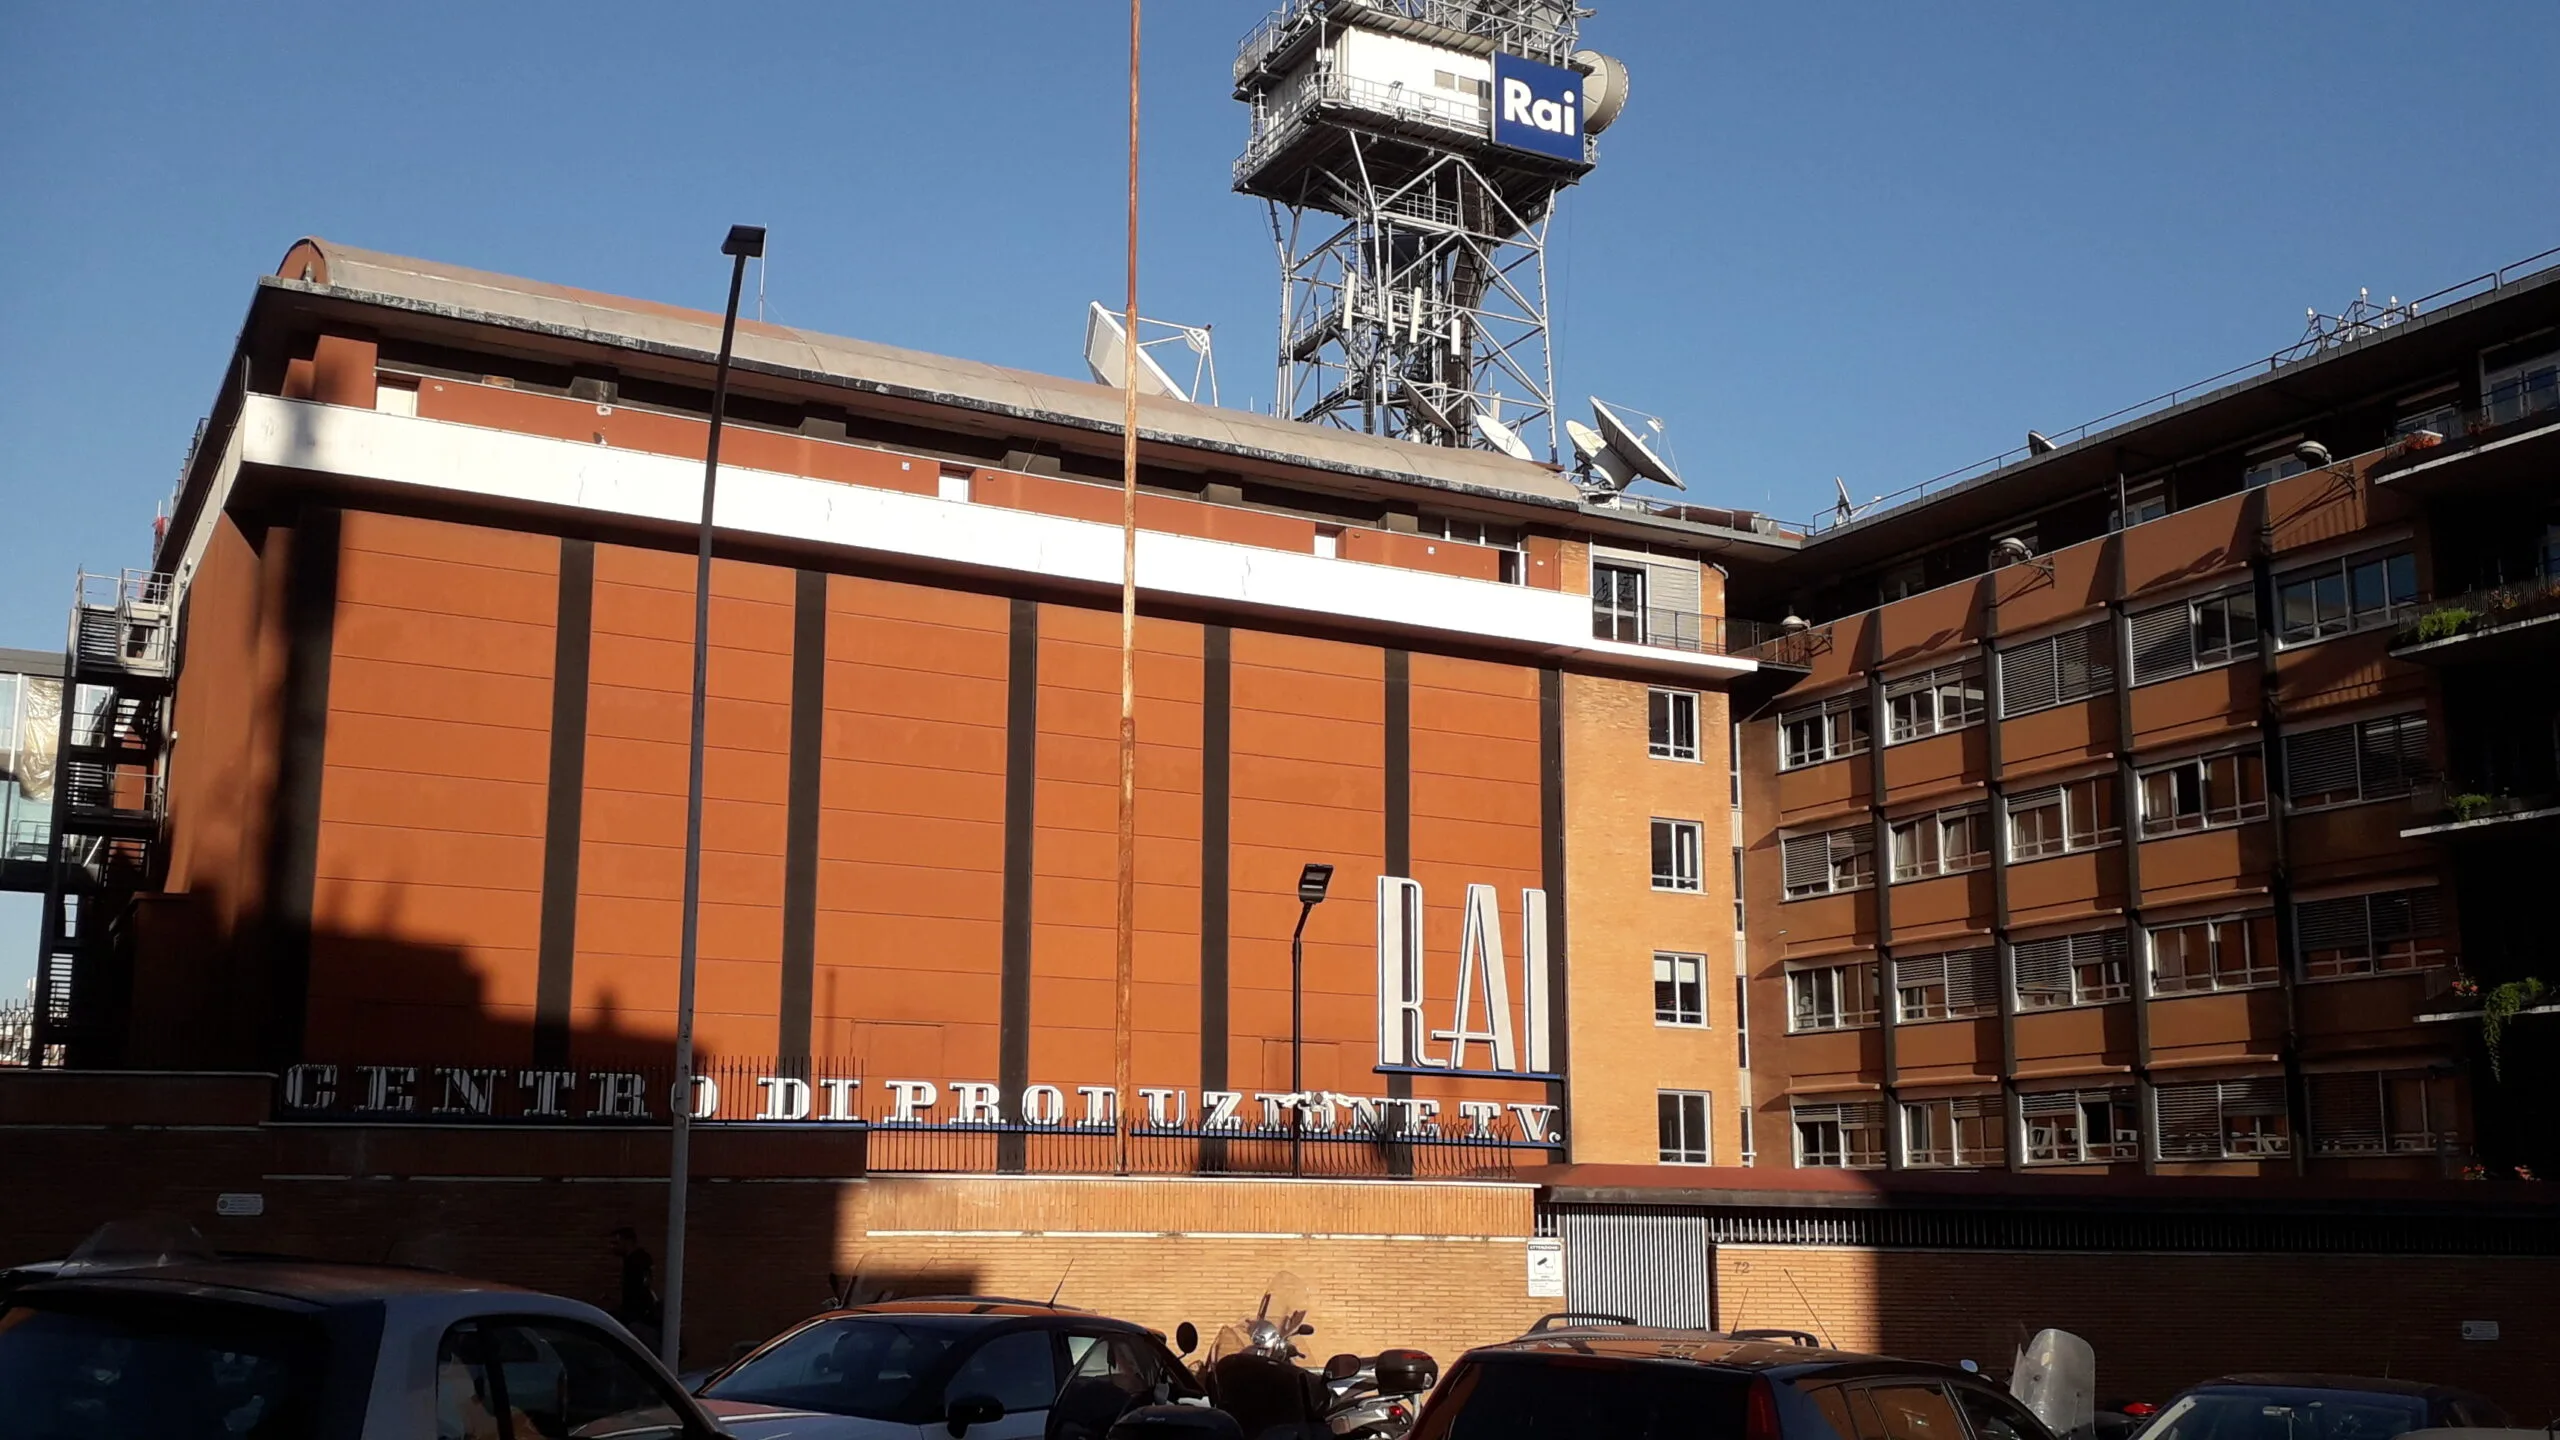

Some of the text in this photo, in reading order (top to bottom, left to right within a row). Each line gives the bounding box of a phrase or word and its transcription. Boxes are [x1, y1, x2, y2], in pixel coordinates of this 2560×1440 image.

[1503, 77, 1575, 136] Rai
[1377, 875, 1550, 1073] RAI
[285, 1063, 718, 1118] CENTRO
[756, 1077, 861, 1120] DI
[884, 1080, 1440, 1139] PRODUZIONE
[1733, 1261, 1750, 1274] 72
